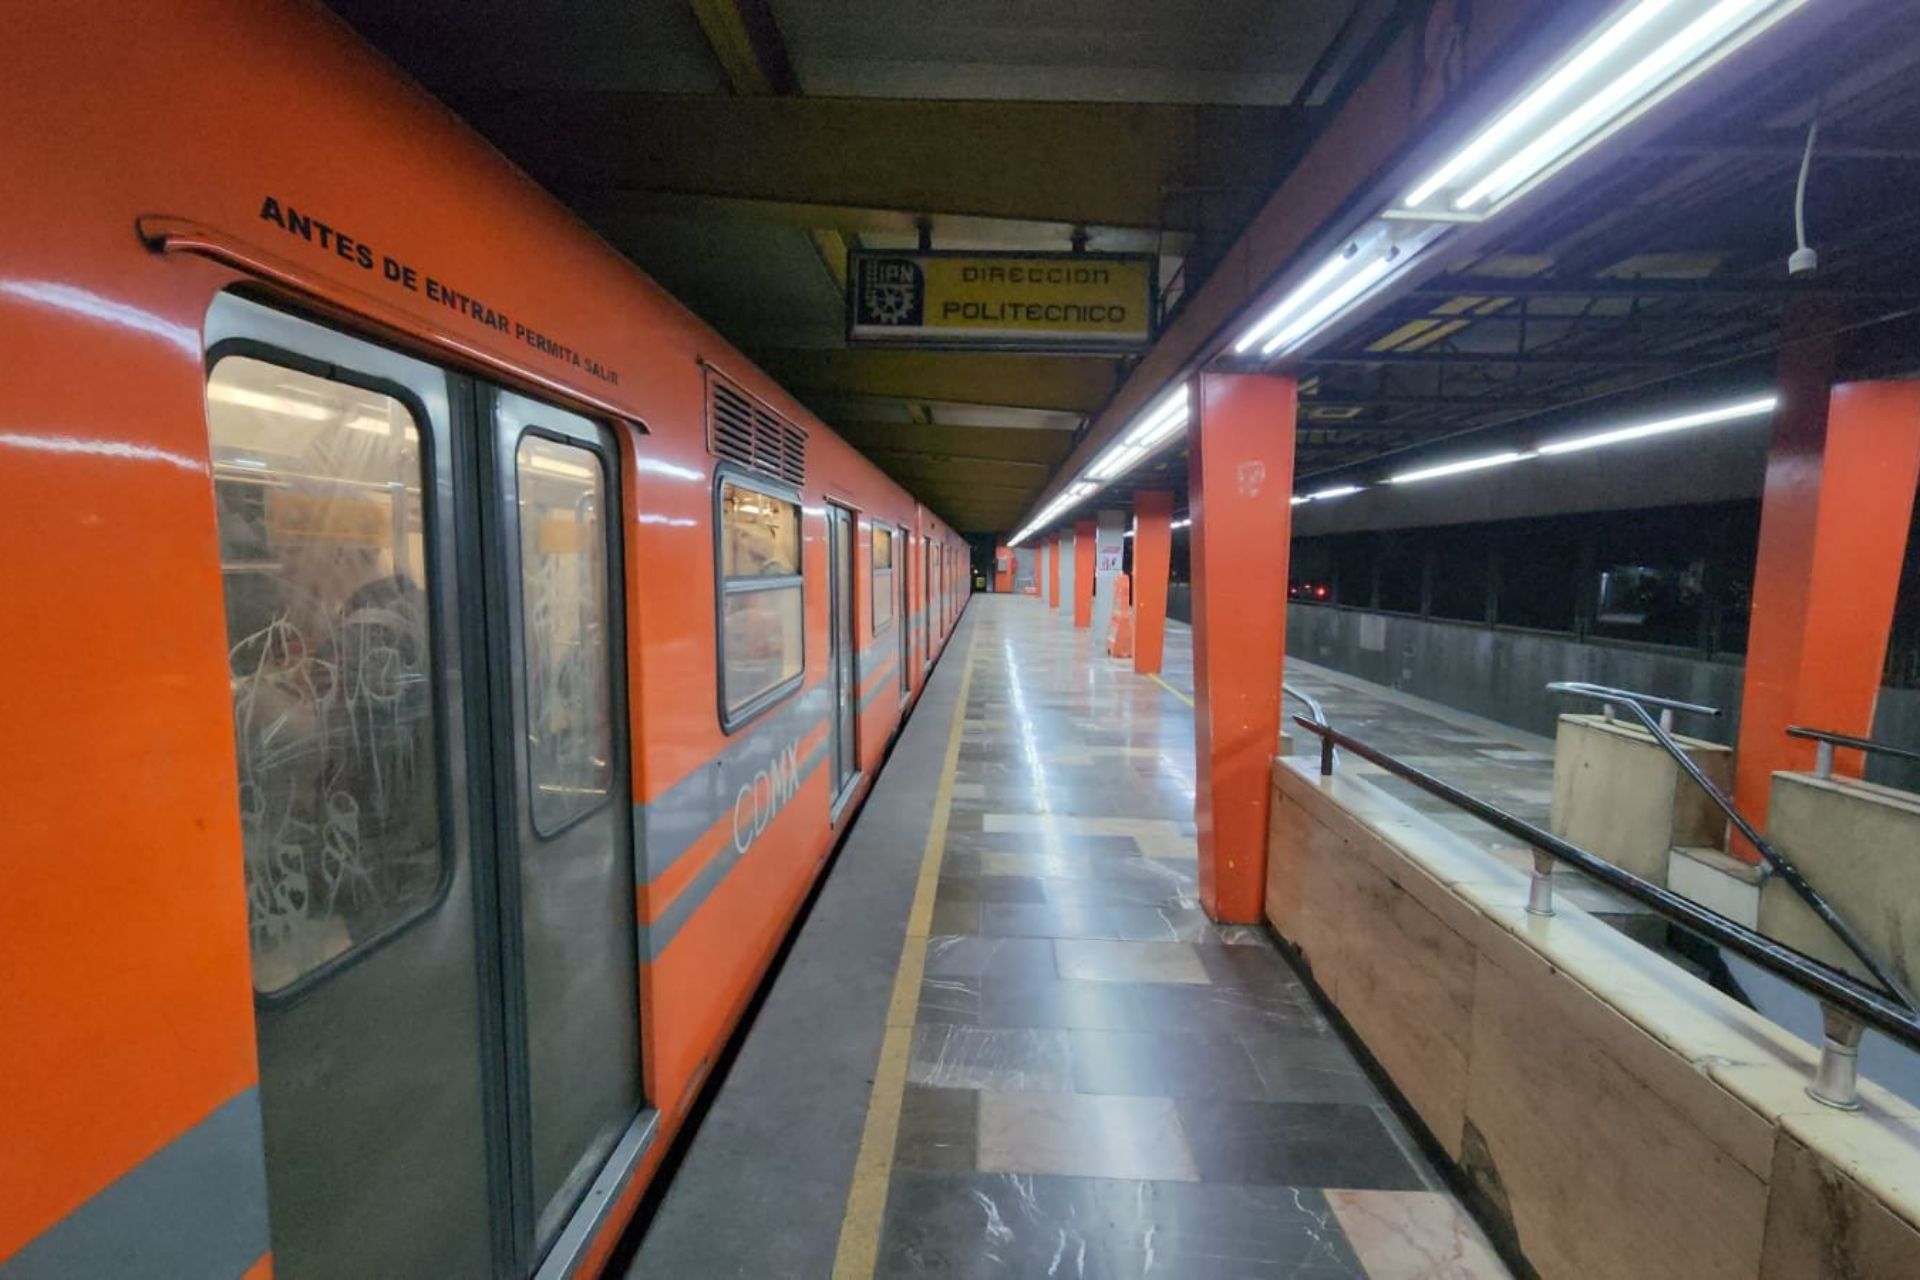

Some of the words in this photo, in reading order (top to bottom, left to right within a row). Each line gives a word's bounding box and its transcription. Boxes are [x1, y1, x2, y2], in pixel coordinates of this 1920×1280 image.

[260, 196, 374, 270] ANTES
[383, 255, 418, 292] DE
[426, 277, 510, 334] ENTRAR
[515, 322, 581, 368] PERMITA
[584, 358, 619, 386] SALIR
[942, 302, 1126, 323] POLITECNICO
[734, 736, 800, 854] CDMX
